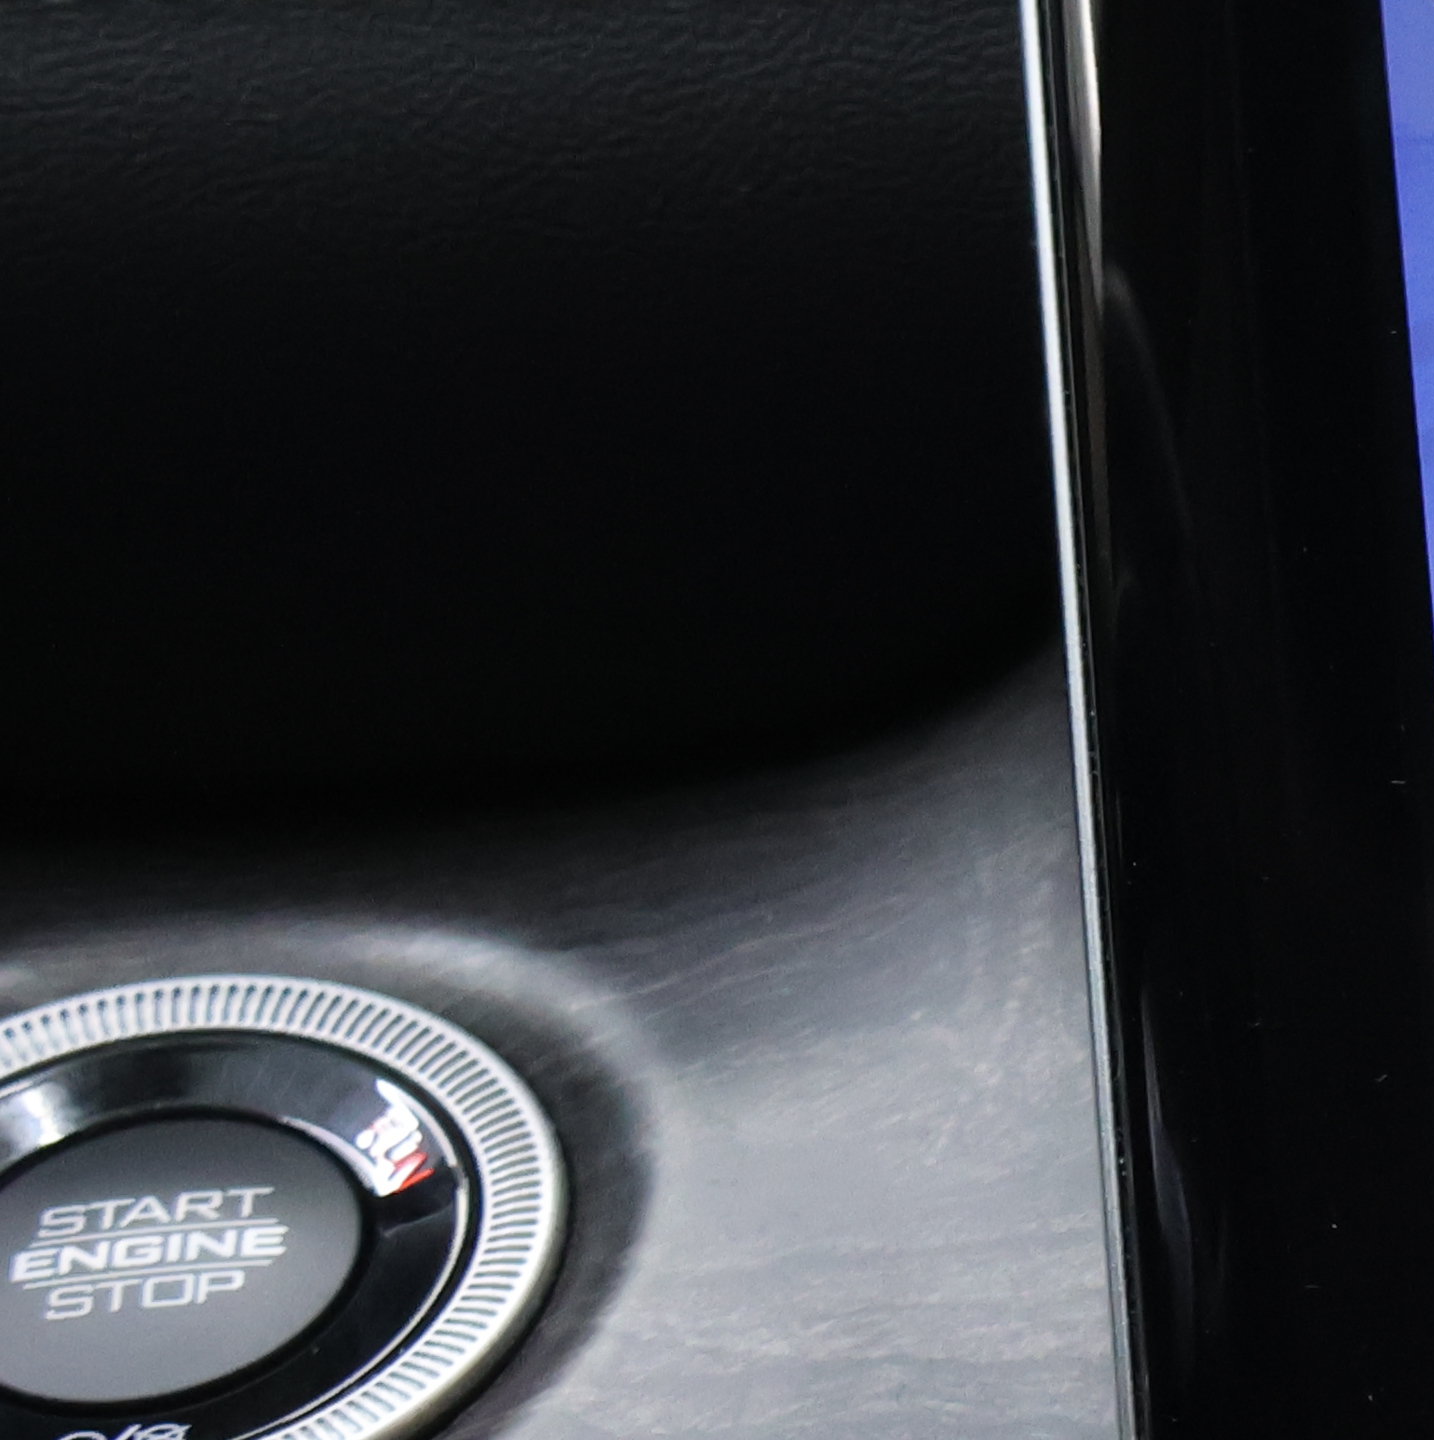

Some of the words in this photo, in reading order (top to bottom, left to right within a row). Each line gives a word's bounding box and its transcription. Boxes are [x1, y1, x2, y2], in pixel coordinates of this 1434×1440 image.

[38, 1186, 274, 1240] START
[9, 1225, 288, 1284] ENGINE
[44, 1269, 245, 1321] STOP
